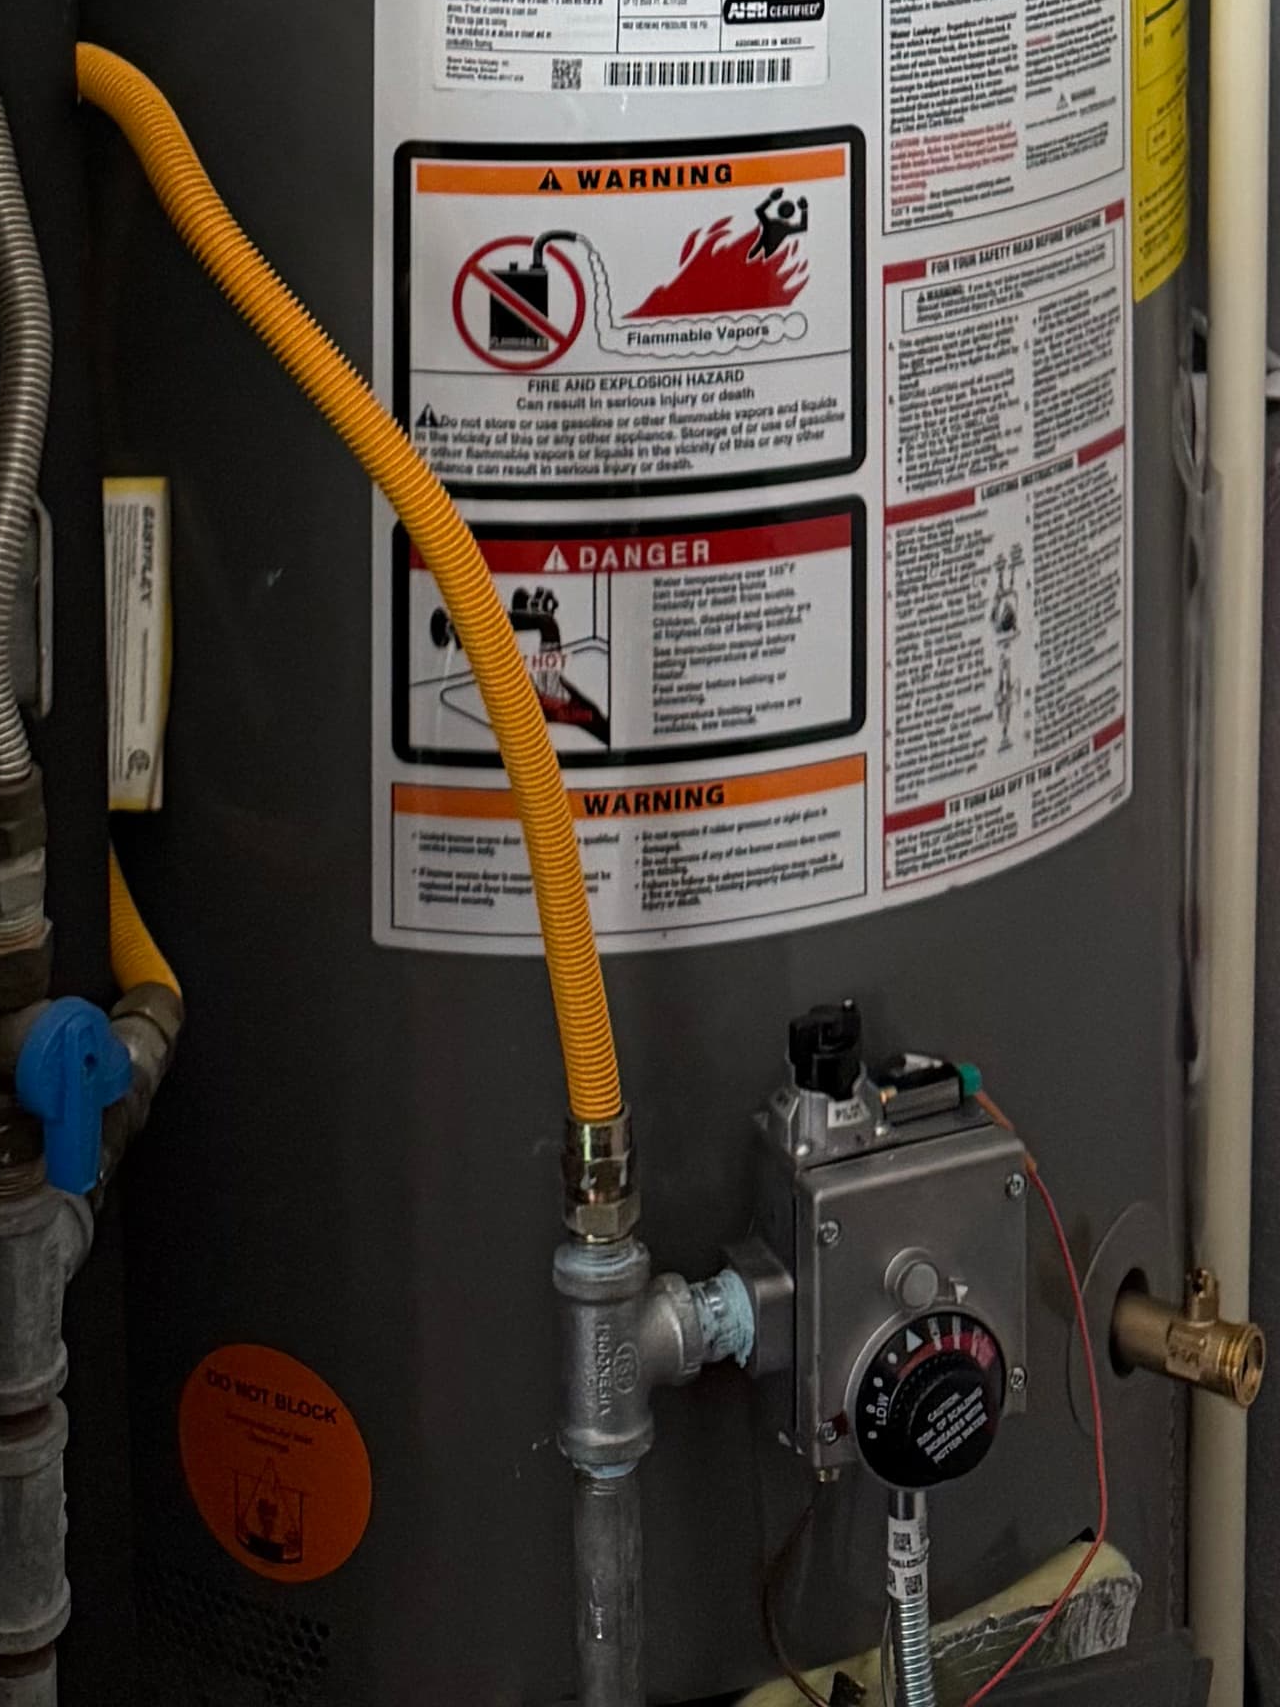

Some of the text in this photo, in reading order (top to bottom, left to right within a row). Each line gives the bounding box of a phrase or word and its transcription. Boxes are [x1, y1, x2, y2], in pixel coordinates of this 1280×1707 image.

[577, 163, 732, 190] WARNING
[930, 258, 950, 275] FOR
[953, 253, 977, 271] YOUR
[979, 245, 1011, 266] SAFETY
[627, 325, 769, 345] Flammable Vapors
[528, 369, 744, 393] FIRE AND EXPLOSION HAZARD
[517, 397, 543, 410] Can
[547, 396, 585, 410] result
[607, 394, 655, 409] serious
[702, 392, 714, 403] or
[719, 388, 754, 402] death
[441, 416, 457, 428] Do
[461, 417, 480, 428] not
[633, 413, 665, 427] other
[735, 405, 774, 420] vapors
[777, 401, 797, 414] and
[579, 540, 710, 571] DANGER
[532, 652, 568, 670] HOT
[583, 784, 725, 817] WARNING
[205, 1368, 338, 1425] DO NOT BLOCK
[875, 1392, 889, 1426] LOW
